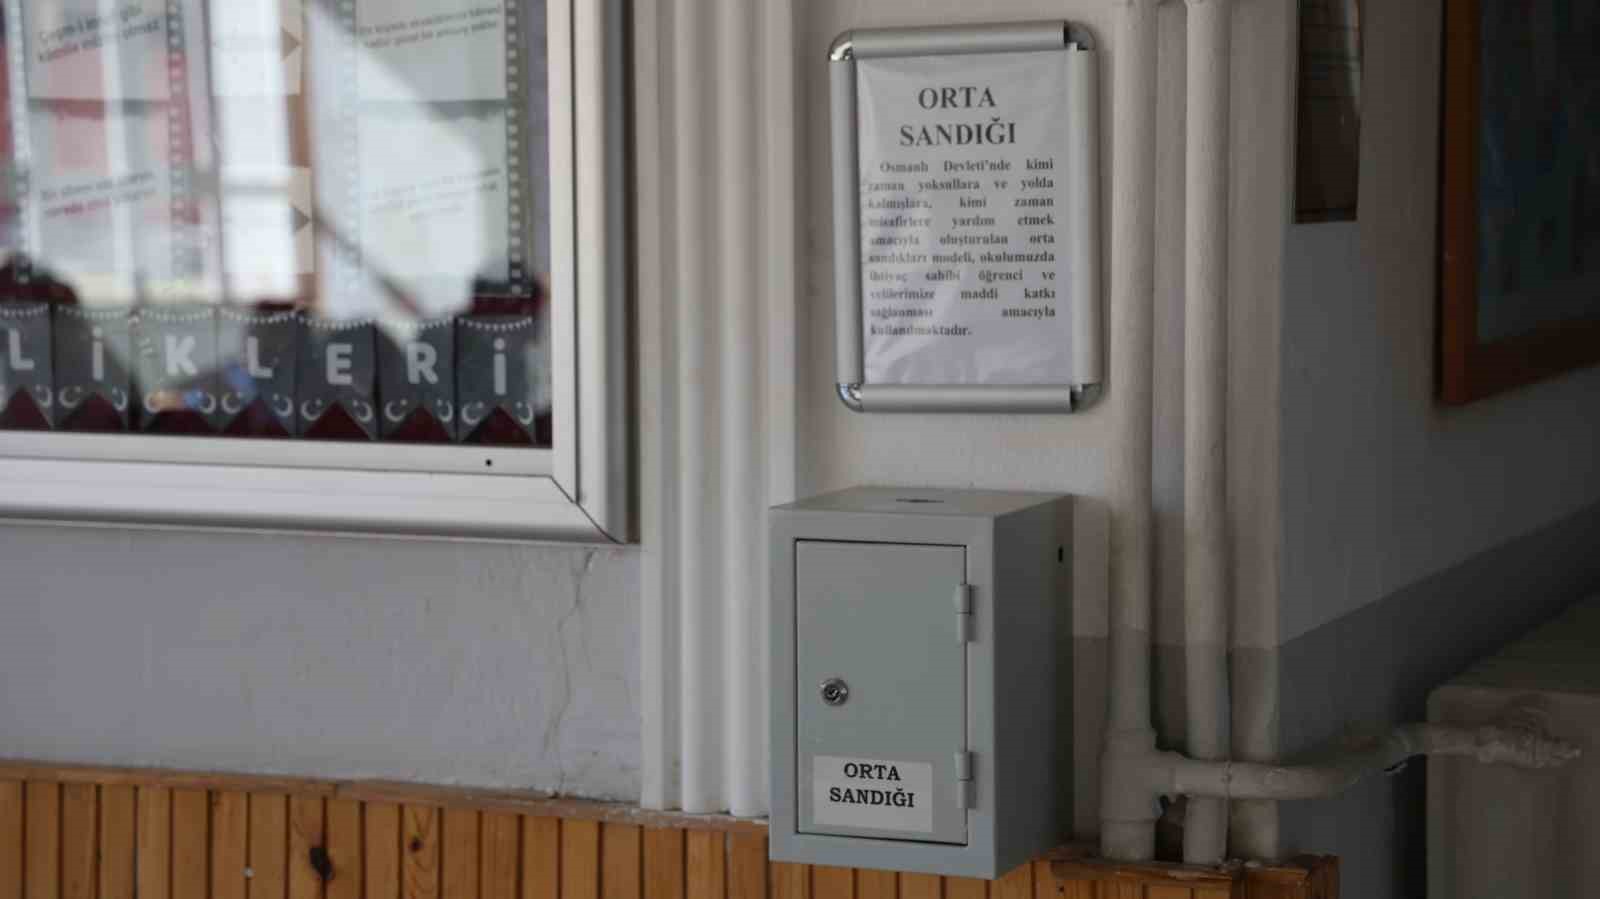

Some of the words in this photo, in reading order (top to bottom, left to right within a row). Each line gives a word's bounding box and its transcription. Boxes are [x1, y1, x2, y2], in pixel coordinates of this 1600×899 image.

[918, 87, 996, 109] ORTA
[900, 116, 1016, 146] SANDIĞI
[1026, 158, 1053, 170] kimi
[918, 178, 979, 192] yoksullara
[995, 180, 1008, 189] ve
[1021, 177, 1053, 191] yolda
[960, 197, 986, 207] kimi
[1014, 197, 1053, 207] zaman
[952, 215, 995, 229] yardım
[1017, 215, 1054, 226] etmek
[940, 234, 1008, 247] oluşturulan
[1029, 234, 1054, 244] orta
[932, 252, 975, 264] modeli,
[980, 252, 1054, 263] okulumuzda
[978, 270, 1023, 284] öğrenci
[1042, 270, 1054, 280] ve
[961, 288, 998, 299] maddi
[1024, 288, 1055, 299] katkı
[1002, 306, 1055, 320] amacıyla
[844, 763, 901, 781] ORTA
[829, 787, 914, 808] SANDIĞI
